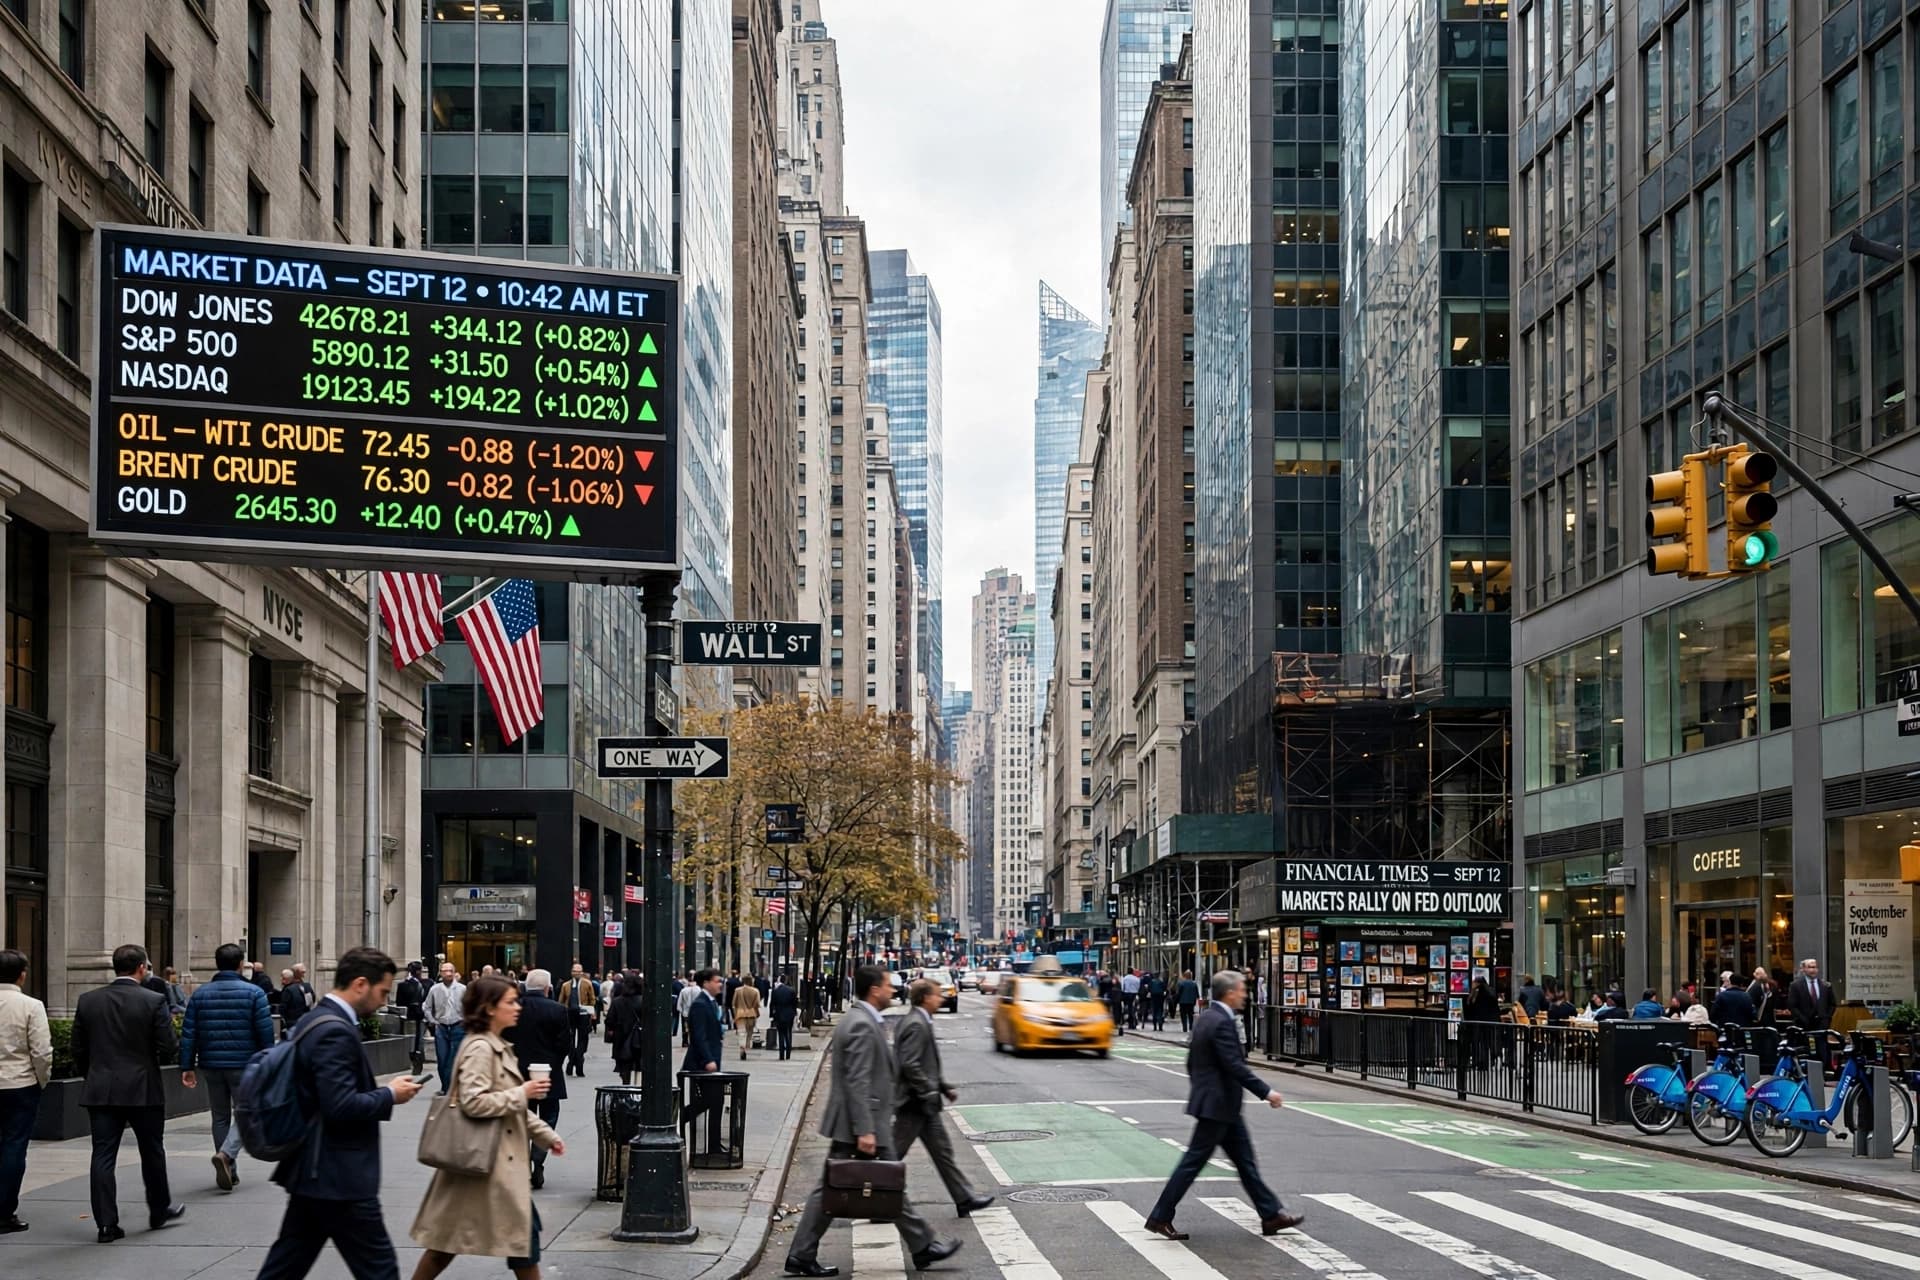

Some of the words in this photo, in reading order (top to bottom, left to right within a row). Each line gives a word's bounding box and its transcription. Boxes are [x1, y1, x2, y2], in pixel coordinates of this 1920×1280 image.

[37, 131, 91, 210] NYSE
[124, 247, 247, 283] MARKET
[255, 259, 327, 290] DATA
[367, 269, 435, 298] SEPT
[442, 277, 467, 301] 12
[498, 281, 562, 310] 10:42
[570, 287, 610, 314] AM
[617, 291, 648, 317] ET
[122, 288, 177, 317] DOW
[188, 294, 273, 325] JONES
[299, 303, 410, 336] 42678.21
[430, 315, 522, 345] +344.12
[535, 321, 630, 357] (+0.82%)
[121, 324, 176, 352] S&P
[187, 329, 237, 357] 500
[312, 339, 410, 371] 5890.12
[430, 350, 509, 378] +31.50
[535, 355, 629, 390] (+0.54%)
[121, 360, 229, 394] NASDAQ
[302, 373, 410, 406] 19123.45
[430, 385, 521, 413] +194.22
[535, 390, 629, 424] (+1.02%)
[119, 412, 167, 442] OIL
[204, 418, 251, 447] WTI
[261, 422, 345, 453] CRUDE
[362, 429, 430, 459] 72.45
[119, 450, 204, 480] BRENT
[213, 455, 297, 485] CRUDE
[361, 466, 430, 495] 76.30
[118, 486, 186, 515] GOLD
[235, 493, 337, 525] 2645.30
[361, 502, 441, 531] +12.40
[455, 505, 552, 539] (+0.47%)
[263, 585, 303, 642] NYSE
[700, 632, 784, 659] WALL
[787, 635, 812, 652] ST
[613, 751, 651, 766] ONE
[666, 751, 705, 766] WAY
[1285, 863, 1375, 881] FINANCIAL
[1379, 865, 1429, 882] TIMES
[1454, 868, 1484, 882] SEPT
[1487, 868, 1501, 882] 12
[1693, 848, 1741, 872] COFFEE
[1282, 890, 1345, 912] MARKETS
[1348, 891, 1390, 912] RALLY
[1392, 891, 1411, 912] ON
[1415, 892, 1439, 912] FED
[1443, 892, 1502, 913] OUTLOOK
